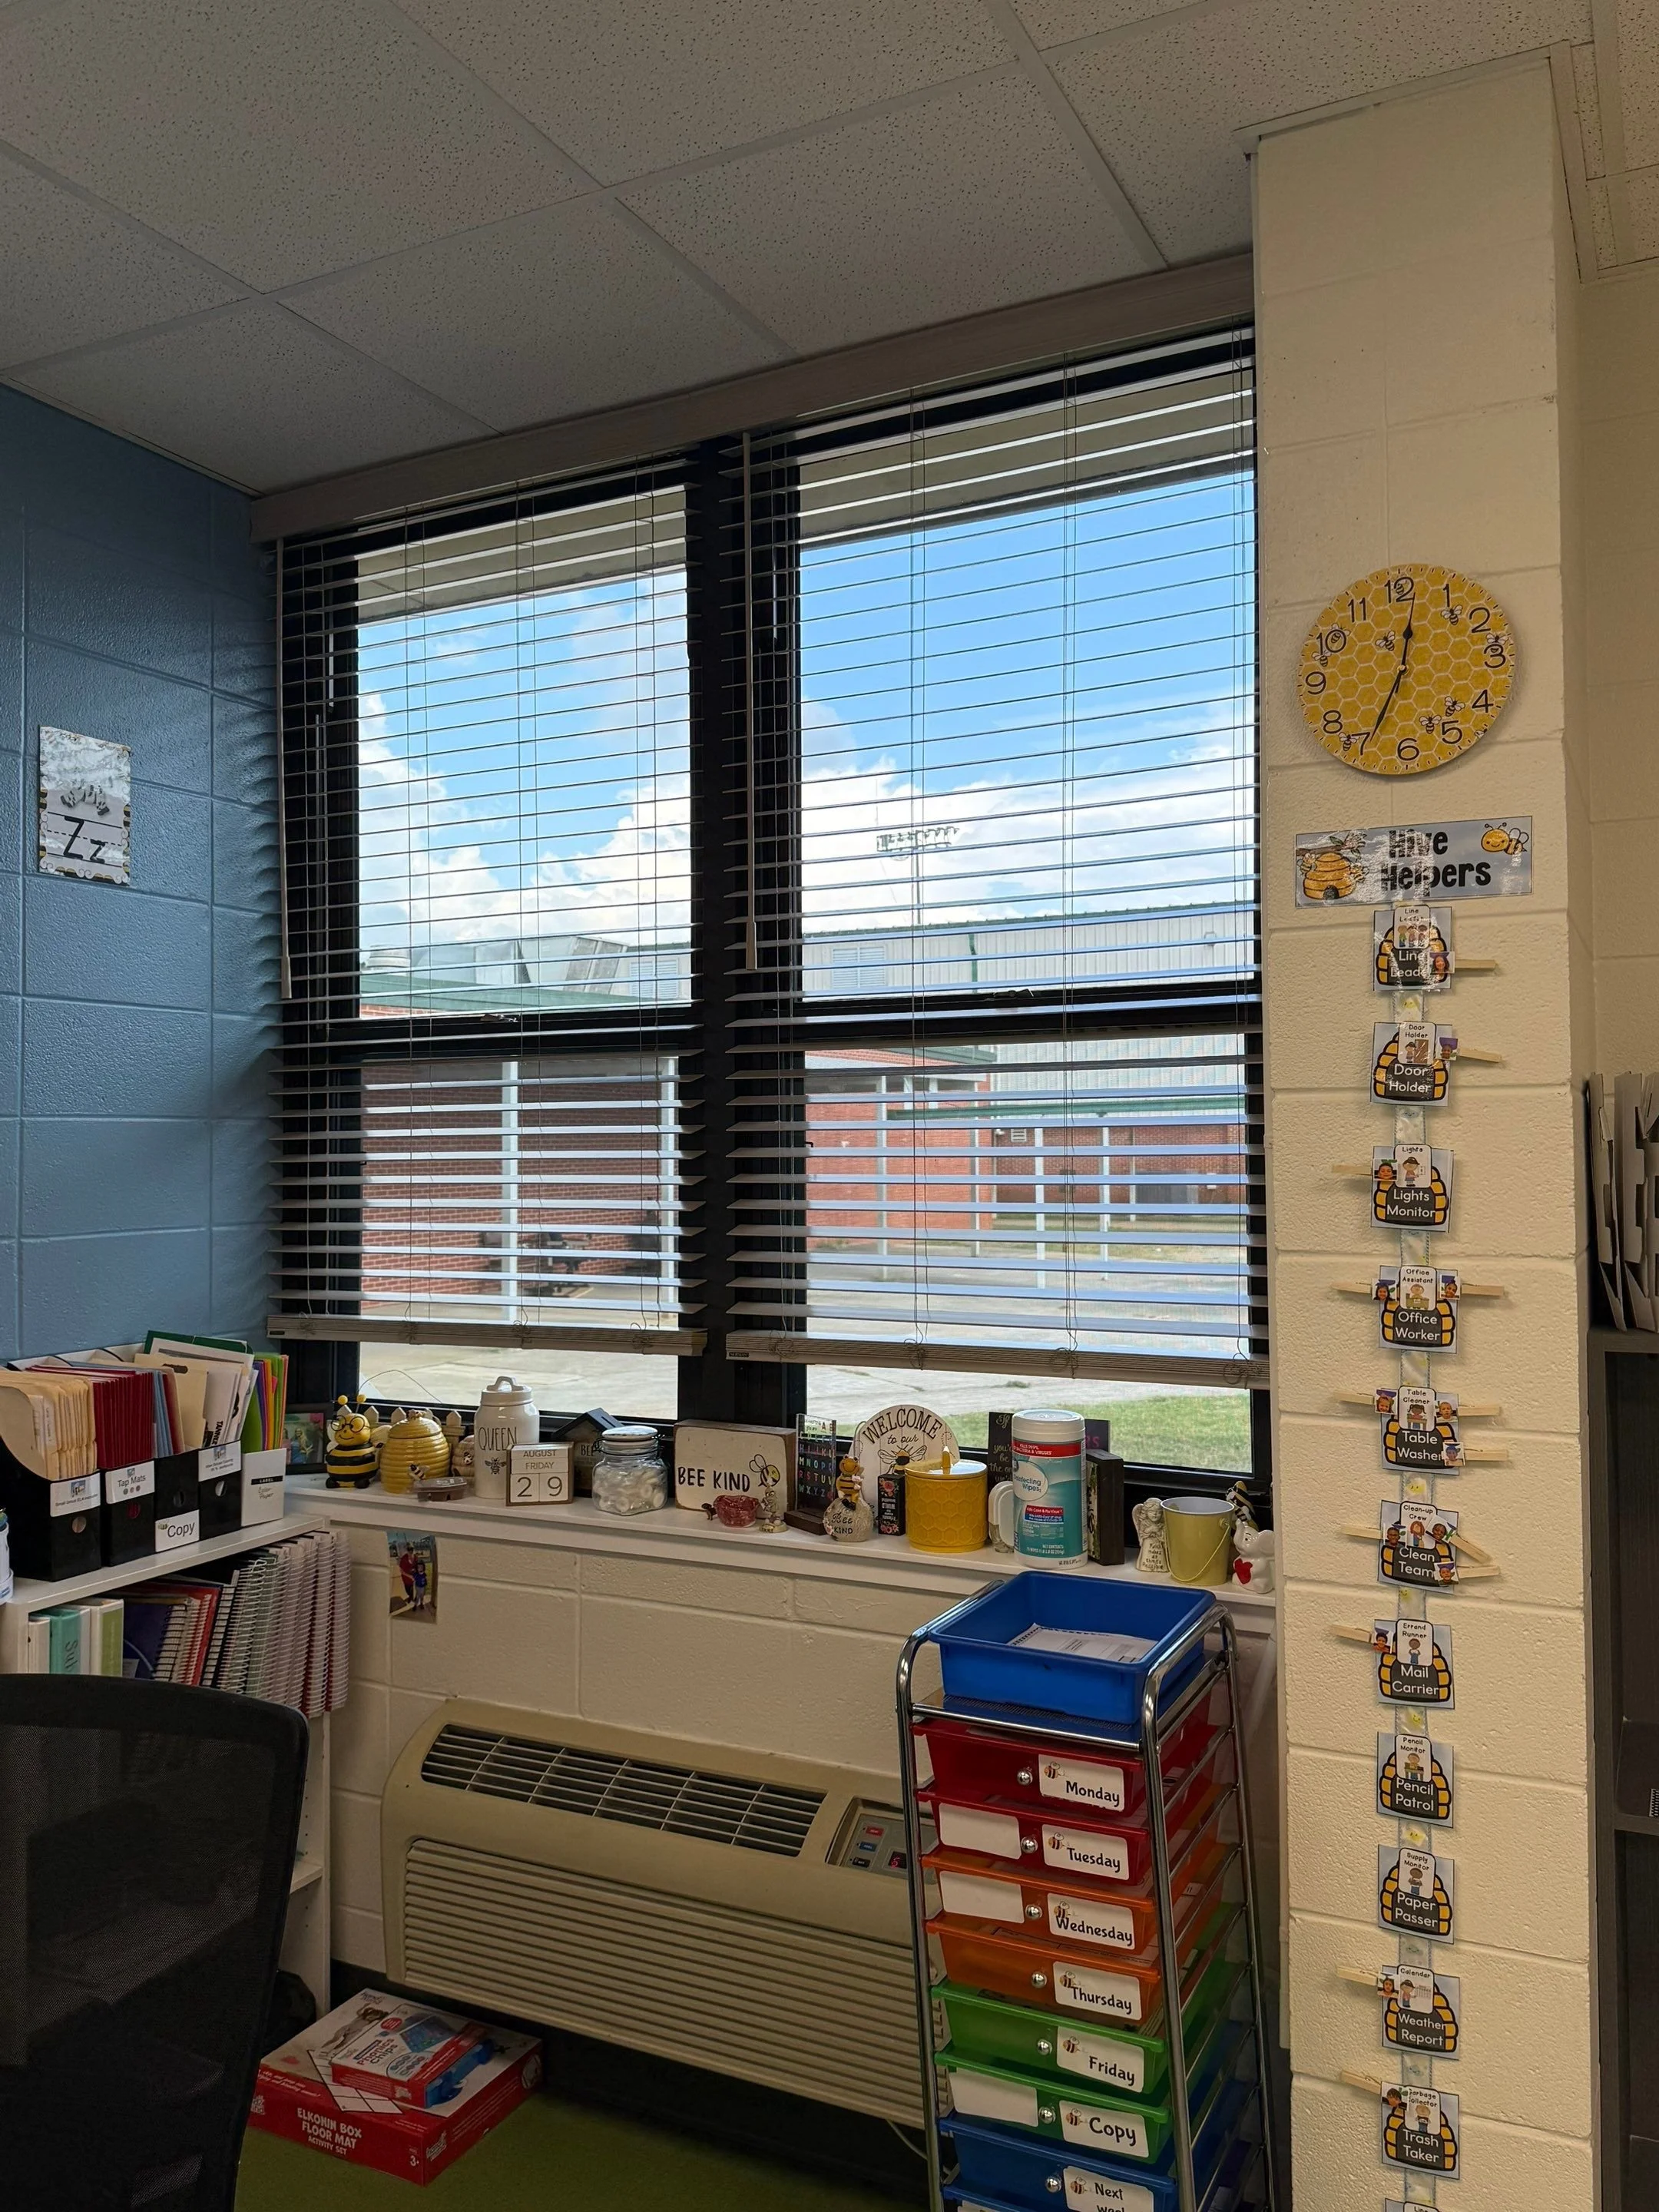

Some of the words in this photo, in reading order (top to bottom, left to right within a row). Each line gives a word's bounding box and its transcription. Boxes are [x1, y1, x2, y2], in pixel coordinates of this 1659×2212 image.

[1384, 577, 1414, 603] 12
[1442, 584, 1450, 608] 1
[1348, 598, 1367, 623] 11
[1469, 607, 1491, 634] 2
[1316, 629, 1347, 653] 10
[1483, 643, 1507, 668] 3
[1305, 671, 1327, 695] 9
[1472, 689, 1494, 714] 4
[1323, 710, 1343, 734] 8
[1441, 720, 1463, 745] 5
[1351, 731, 1371, 756] 7
[1397, 737, 1420, 761] 6
[1389, 829, 1448, 858] Hive
[1394, 1064, 1429, 1076] Door
[1389, 1081, 1432, 1093] Holder
[1393, 1189, 1430, 1203] Lights
[1386, 1205, 1436, 1217] Monitor
[1398, 1312, 1438, 1324] Office
[1395, 1327, 1440, 1341] Worker
[862, 1409, 943, 1445] WELCOME
[478, 1426, 518, 1452] QUEEN
[887, 1434, 898, 1444] to
[900, 1433, 919, 1443] our
[1402, 1431, 1438, 1444] Table
[523, 1449, 557, 1459] AUGUST
[1397, 1447, 1442, 1461] Washer
[525, 1461, 555, 1471] FRIDAY
[118, 1479, 130, 1488] Tap
[130, 1475, 147, 1485] Mats
[517, 1475, 532, 1498] 2
[546, 1475, 563, 1498] 9
[677, 1467, 706, 1487] BEE
[713, 1470, 750, 1492] KIND
[831, 1512, 853, 1524] Bee
[1403, 1505, 1433, 1515] Clean-up
[167, 1522, 195, 1538] Copy
[833, 1526, 853, 1535] KIND
[1399, 1548, 1435, 1562] Clean
[1399, 1561, 1435, 1578] Team
[1402, 1631, 1427, 1639] Runner
[1401, 1664, 1429, 1678] Mail
[1392, 1681, 1439, 1695] Carrier
[1400, 1745, 1426, 1754] Monitor
[1402, 1737, 1423, 1746] Pencil
[1065, 1780, 1121, 1808] Monday
[1396, 1777, 1434, 1796] Pencil
[1396, 1793, 1434, 1811] Patrol
[1066, 1846, 1121, 1873] Tuesday
[1404, 1859, 1430, 1871] Monitor
[1406, 1852, 1429, 1864] Supply
[1397, 1892, 1436, 1911] Paper
[1395, 1907, 1439, 1928] Passer
[1055, 1916, 1133, 1947] Wednesday
[1400, 1967, 1431, 1979] Calendar
[1071, 1985, 1133, 2015] Thursday
[1398, 2012, 1445, 2030] Weather
[1401, 2028, 1444, 2046] Report
[1088, 2055, 1136, 2087] Friday
[297, 2107, 337, 2131] ELKONIN
[339, 2122, 363, 2139] BOX
[1088, 2117, 1137, 2147] Copy
[302, 2121, 333, 2141] FLOOR
[334, 2133, 357, 2149] MAT
[1402, 2128, 1439, 2147] Trash
[308, 2135, 334, 2151] ACTIVITY
[335, 2145, 348, 2155] SET
[1403, 2144, 1439, 2163] Taker
[1094, 2182, 1124, 2200] Next
